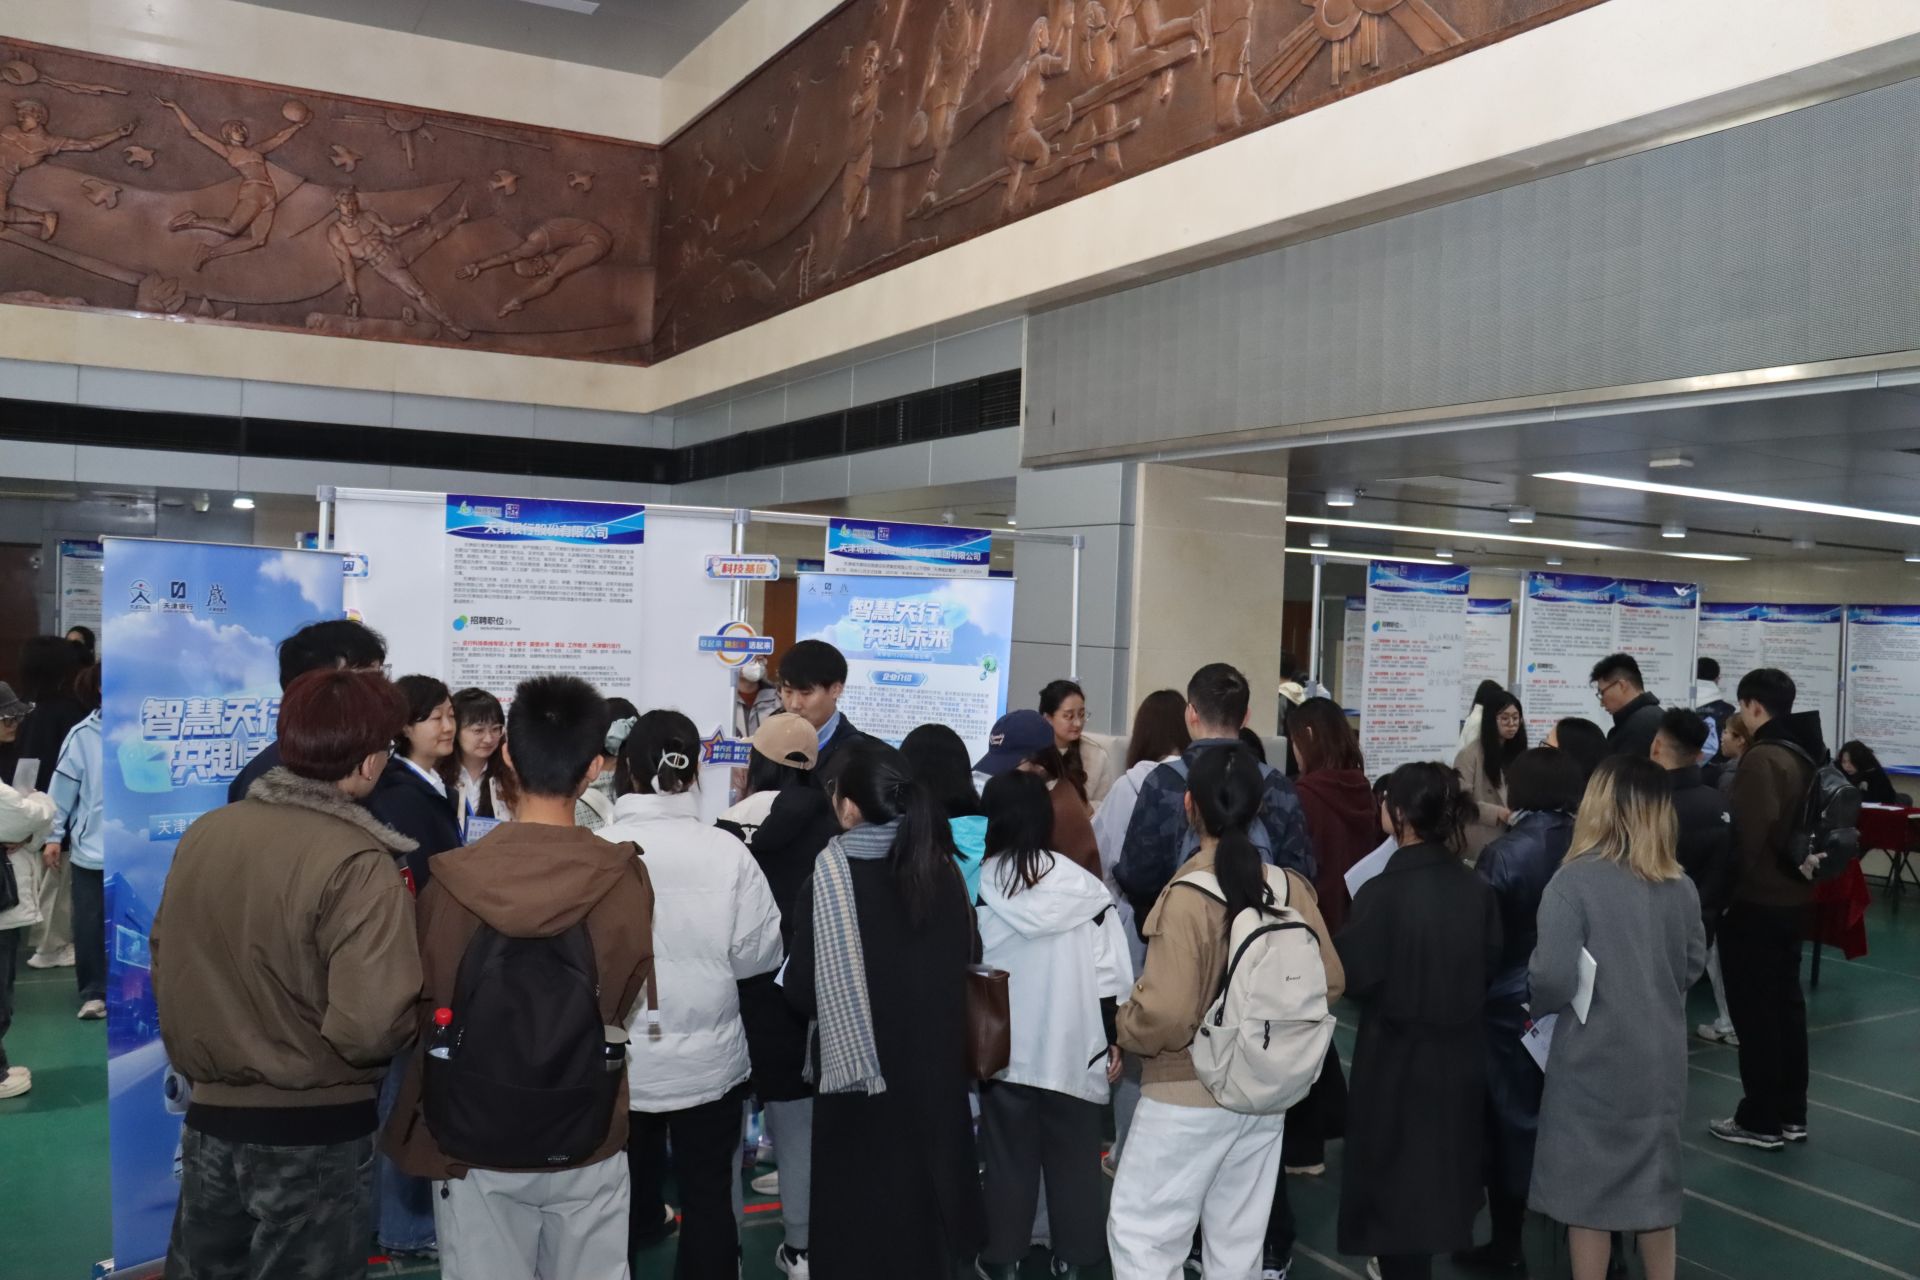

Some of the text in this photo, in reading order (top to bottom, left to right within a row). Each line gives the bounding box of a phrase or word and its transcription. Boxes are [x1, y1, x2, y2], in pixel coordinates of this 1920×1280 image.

[722, 563, 767, 574] 科技基因
[470, 616, 504, 625] 招聘职位
[851, 599, 940, 625] 智慧天行
[863, 625, 951, 649] 共赴未来
[172, 740, 270, 784] 共赴
[158, 819, 195, 836] 天津
